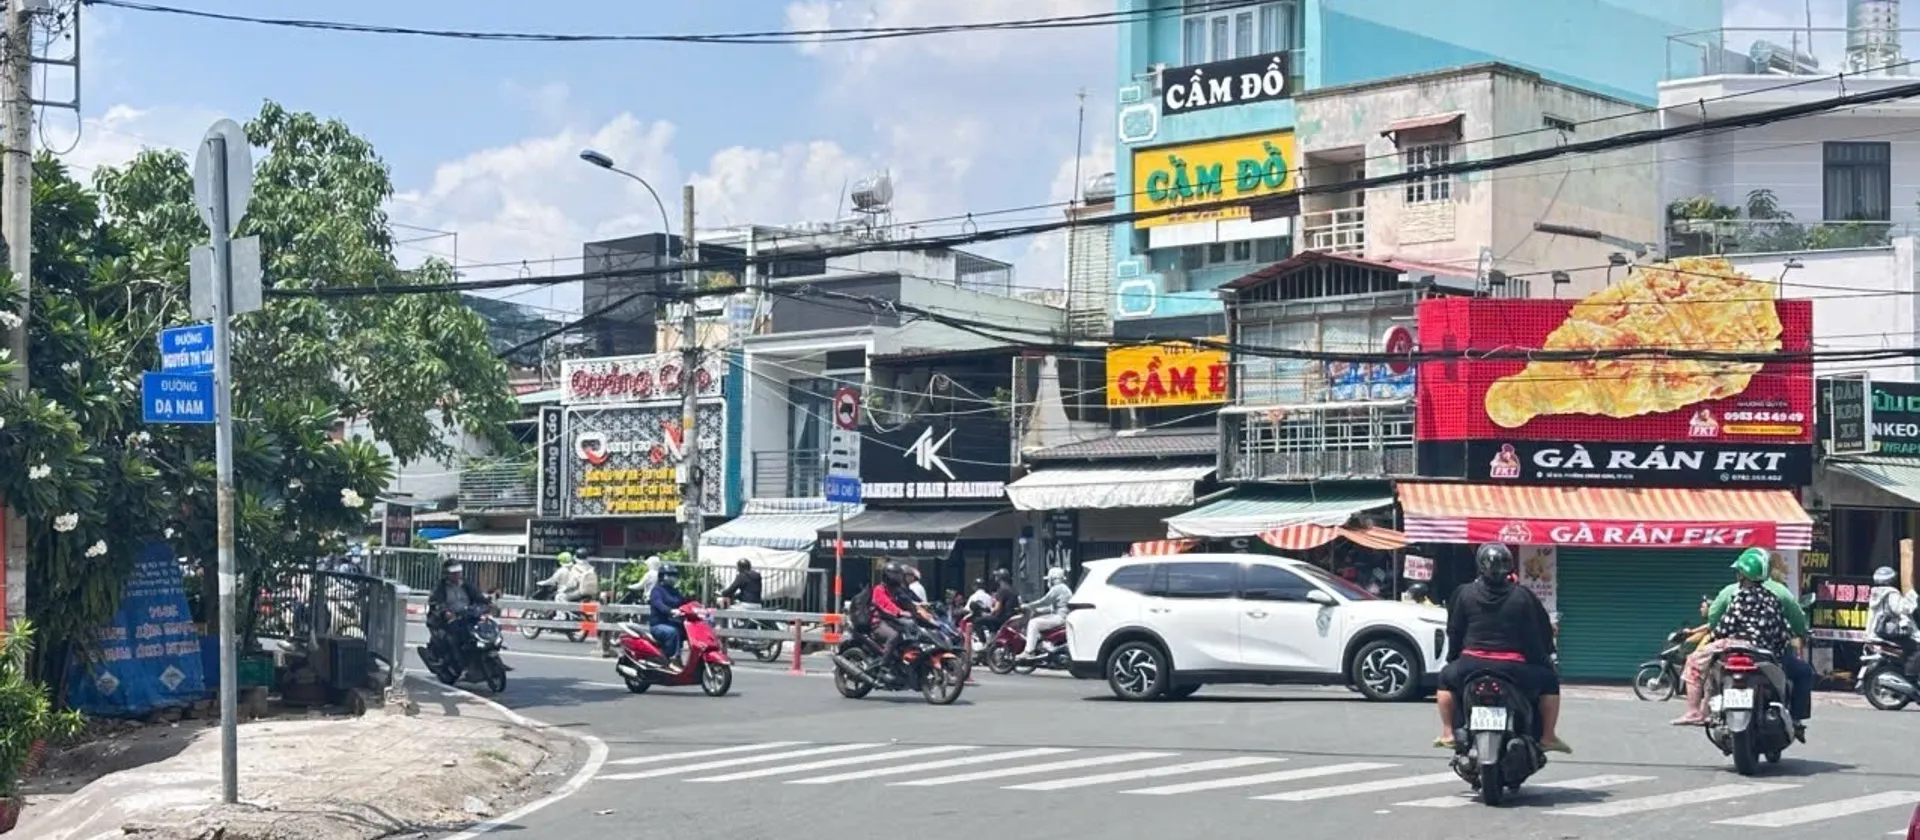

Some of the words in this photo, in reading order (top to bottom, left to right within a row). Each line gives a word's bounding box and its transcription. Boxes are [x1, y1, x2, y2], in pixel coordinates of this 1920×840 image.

[1166, 68, 1232, 110] CẦM
[1240, 56, 1285, 99] ĐỒ
[1146, 155, 1223, 202] CẦM
[1236, 140, 1288, 192] ĐỒ
[175, 332, 203, 346] ĐƯỜNG
[571, 363, 653, 398] Quảng
[660, 363, 713, 392] Co
[1117, 356, 1198, 398] CẦM
[155, 399, 173, 418] DẠ
[176, 400, 204, 415] NAM
[546, 412, 558, 444] Cáo
[1692, 426, 1716, 436] FKT
[1533, 444, 1595, 469] GÀ
[1606, 444, 1705, 471] RÁN
[1713, 451, 1787, 471] FKT
[545, 446, 559, 498] Quảng
[1494, 467, 1517, 477] FKT
[917, 482, 946, 498] HAIR
[947, 481, 1006, 498] BRAIDING
[1551, 522, 1595, 543] GÀ
[1602, 522, 1676, 544] RÁN
[1682, 528, 1755, 545] FKT
